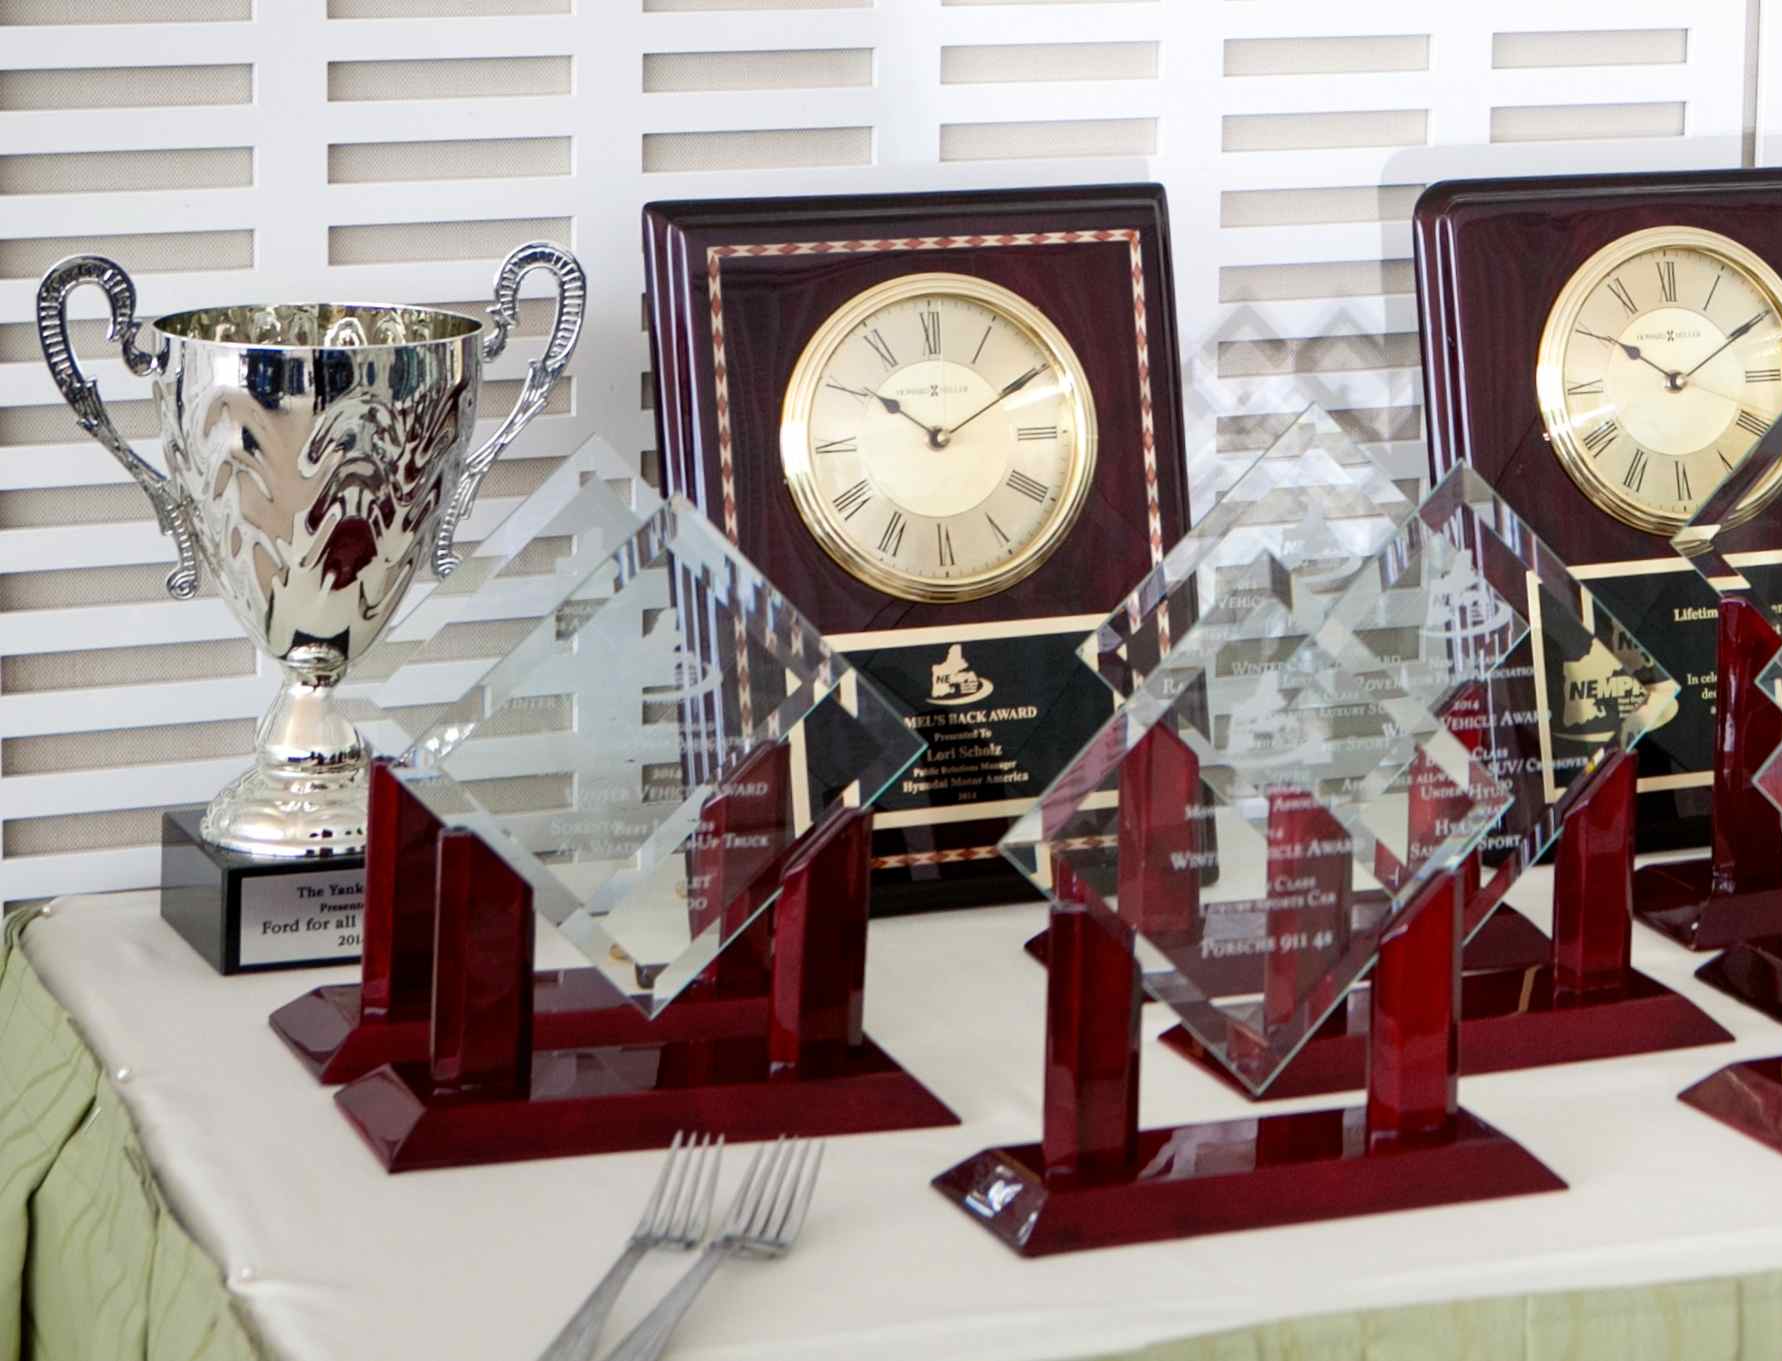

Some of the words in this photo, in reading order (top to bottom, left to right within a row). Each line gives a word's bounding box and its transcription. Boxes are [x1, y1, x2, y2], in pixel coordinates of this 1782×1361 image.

[1674, 607, 1719, 622] Lifetim
[988, 706, 1038, 724] AWARD
[725, 832, 770, 848] TRUCK
[1477, 834, 1522, 850] SPORT
[297, 885, 325, 899] The
[329, 883, 364, 896] Yank
[320, 902, 364, 914] Present
[261, 919, 300, 935] Ford
[305, 917, 331, 931] for
[335, 915, 357, 929] all
[338, 934, 364, 946] 201
[1201, 935, 1277, 959] PORSCHE
[1280, 931, 1308, 952] 911
